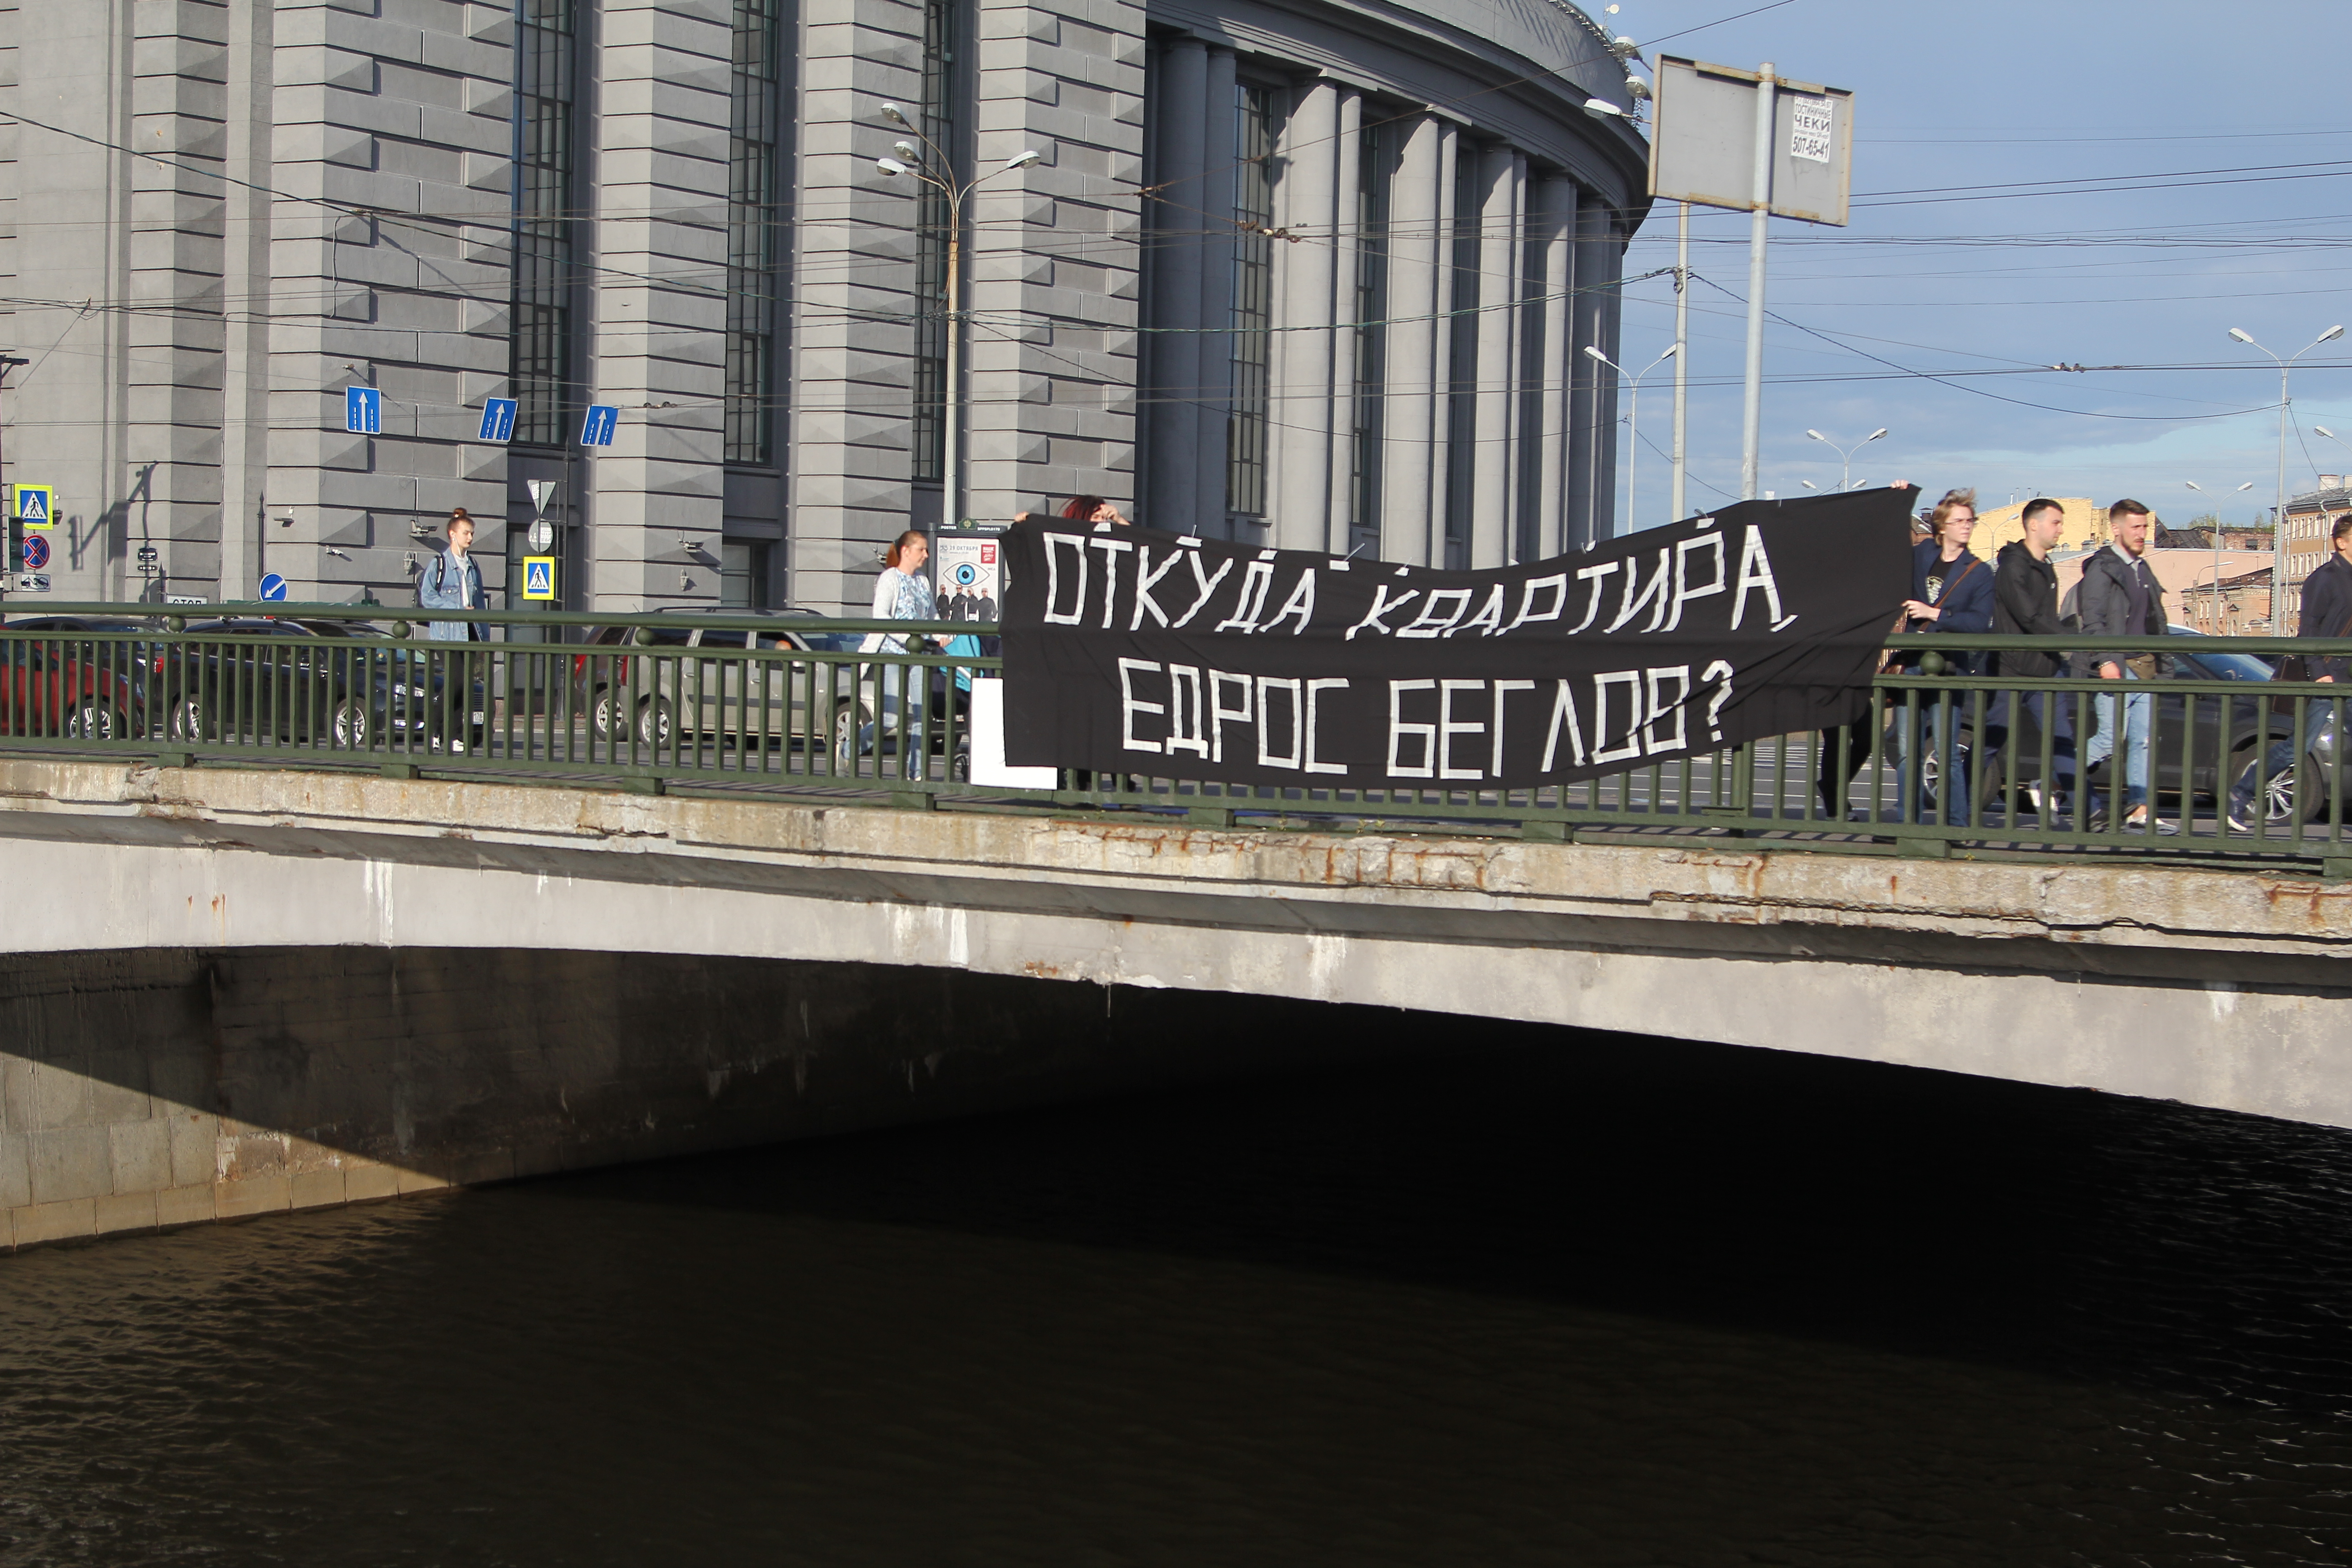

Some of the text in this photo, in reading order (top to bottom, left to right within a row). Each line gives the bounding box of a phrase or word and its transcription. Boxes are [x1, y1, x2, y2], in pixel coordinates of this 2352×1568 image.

[1796, 103, 1831, 120] ГОСТИНИЧНЫЕ
[1794, 114, 1831, 132] ЧЕКИ
[1793, 136, 1829, 158] 507-65-41
[1043, 532, 1315, 635] ОТКУДА
[1118, 657, 1735, 780] ЕДРОС БЕГЛОВ?
